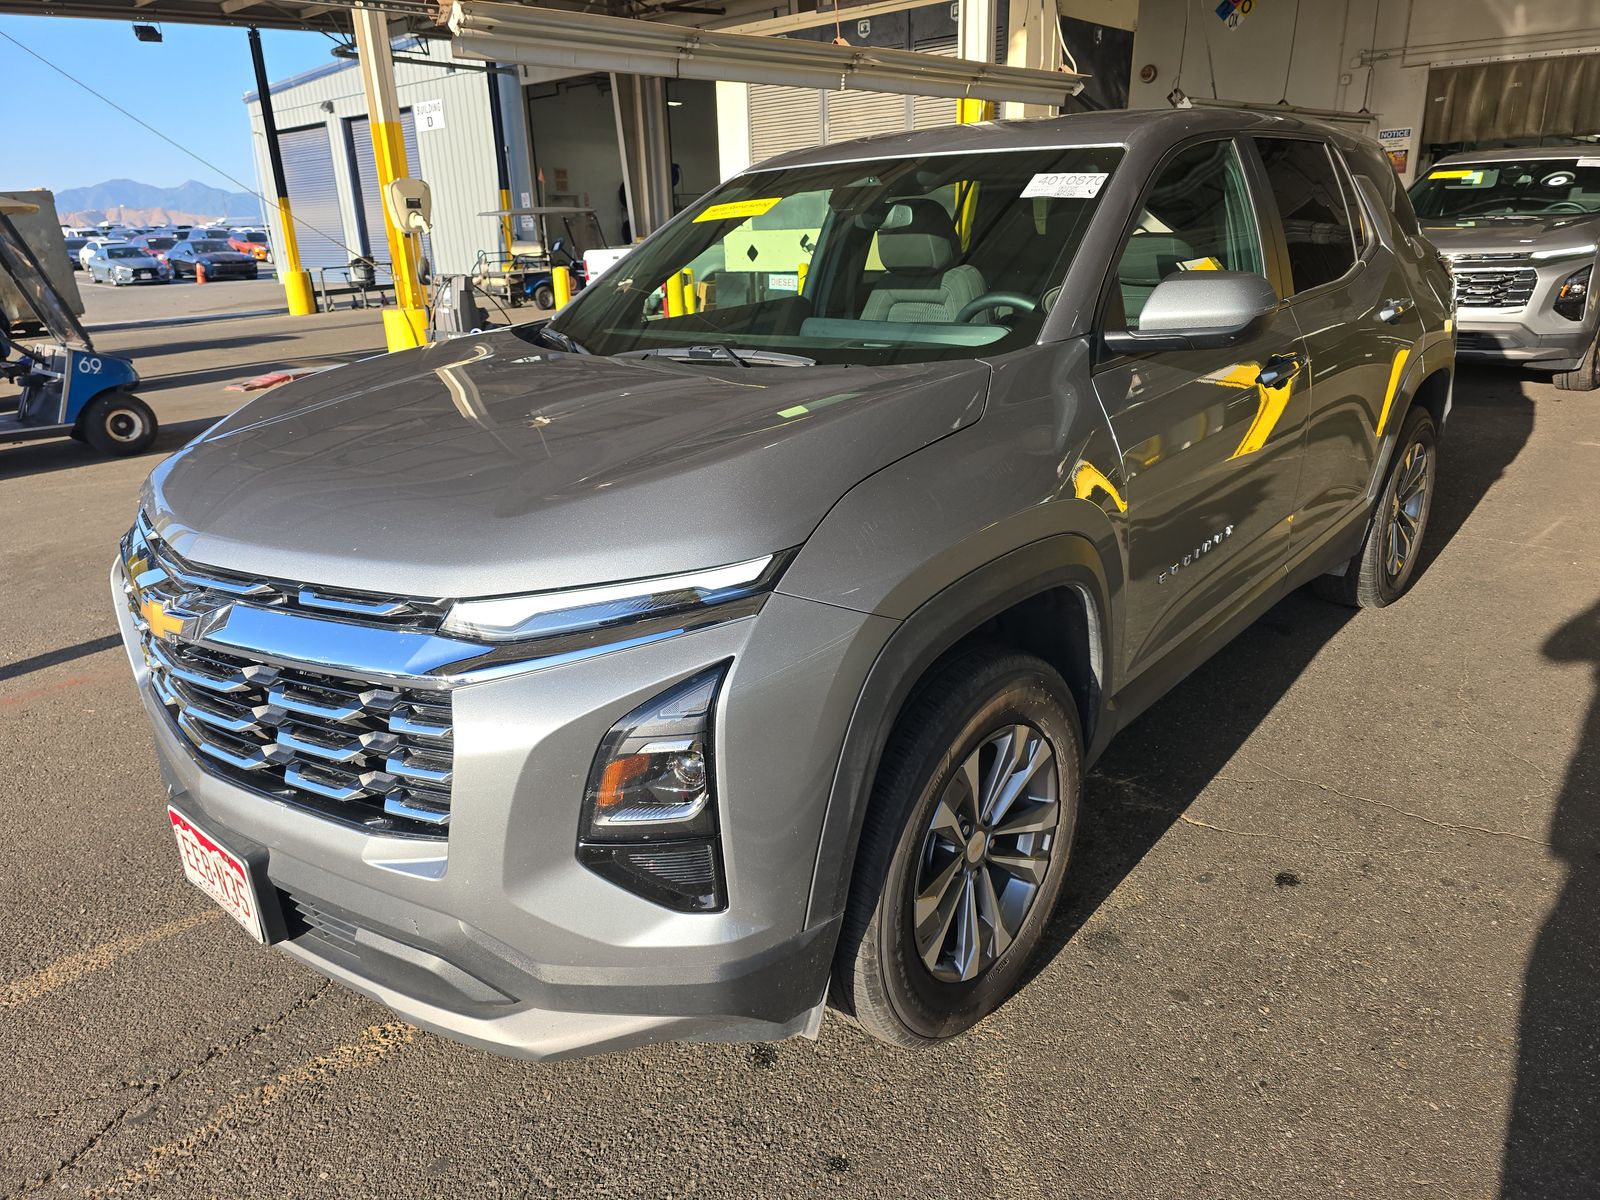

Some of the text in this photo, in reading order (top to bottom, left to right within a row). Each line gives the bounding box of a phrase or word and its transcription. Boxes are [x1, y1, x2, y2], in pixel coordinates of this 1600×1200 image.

[1380, 129, 1410, 139] NOTICE
[771, 278, 797, 288] DIESEL
[78, 356, 102, 375] 69
[1157, 524, 1234, 585] EQUINOX
